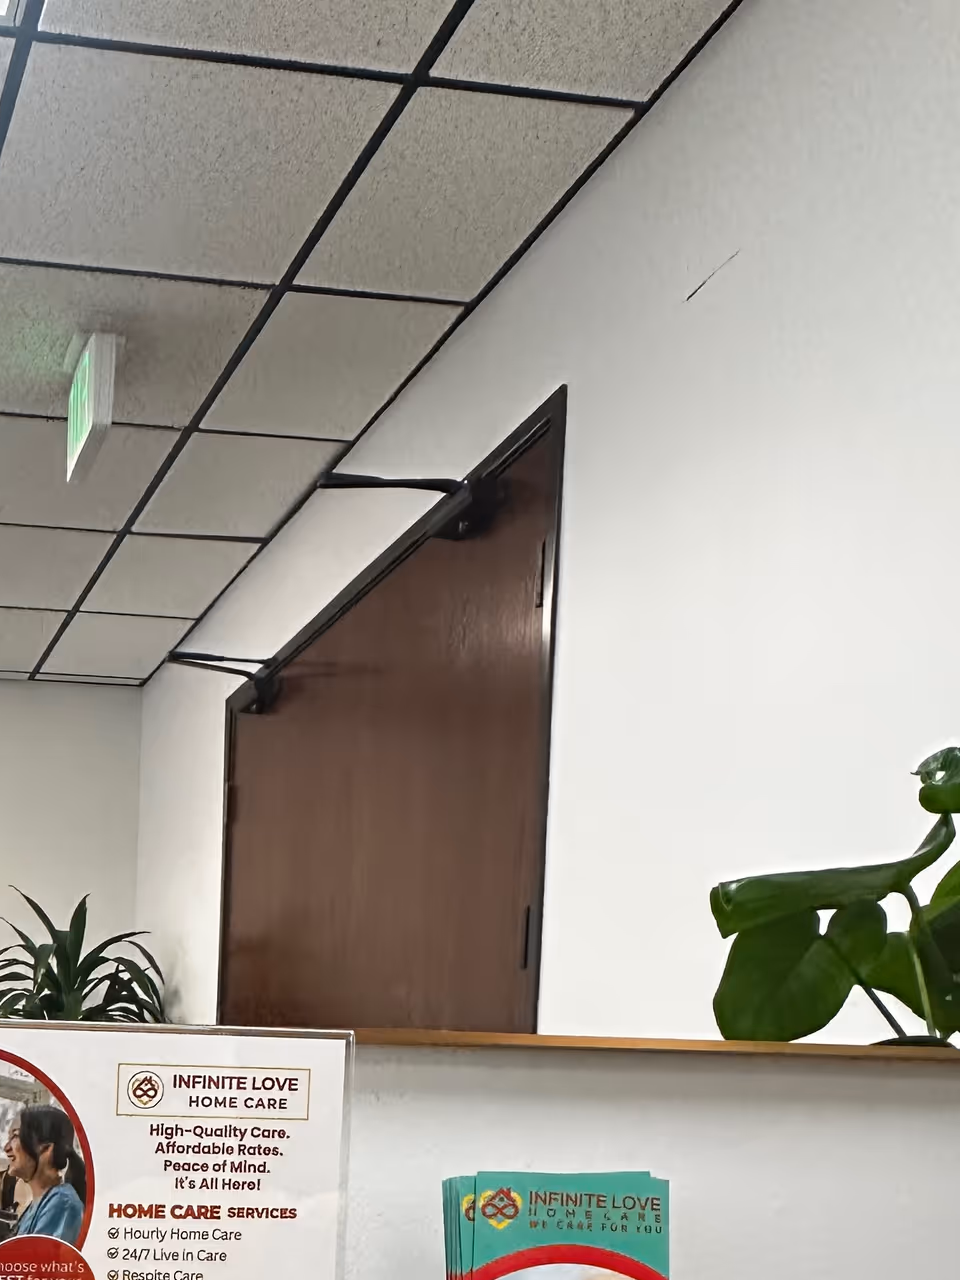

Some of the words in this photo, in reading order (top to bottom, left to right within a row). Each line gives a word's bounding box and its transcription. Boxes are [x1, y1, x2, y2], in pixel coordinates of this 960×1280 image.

[173, 1074, 247, 1090] INFINITE
[252, 1077, 298, 1091] LOVE
[189, 1096, 238, 1109] HOME
[244, 1097, 288, 1110] CARE
[149, 1124, 248, 1141] High-Quality
[250, 1127, 290, 1139] Care.
[155, 1142, 234, 1155] Affordable
[238, 1144, 283, 1156] Rates.
[164, 1160, 209, 1172] Peace
[212, 1160, 227, 1172] of
[230, 1161, 270, 1174] Mind.
[175, 1177, 195, 1189] It's
[199, 1178, 218, 1190] All
[222, 1178, 261, 1191] Here!
[529, 1191, 607, 1208] INFINITE
[612, 1194, 661, 1211] LOVE
[108, 1203, 166, 1219] HOME
[170, 1205, 221, 1220] CARE
[227, 1207, 297, 1219] SERVICES
[602, 1222, 628, 1232] FOR
[636, 1225, 662, 1233] YOU
[123, 1227, 167, 1243] Hourly
[170, 1228, 209, 1240] Home
[212, 1228, 242, 1241] Care
[122, 1248, 150, 1262] 24/7
[154, 1248, 179, 1261] Live
[197, 1249, 227, 1262] Care
[41, 1260, 84, 1273] what's
